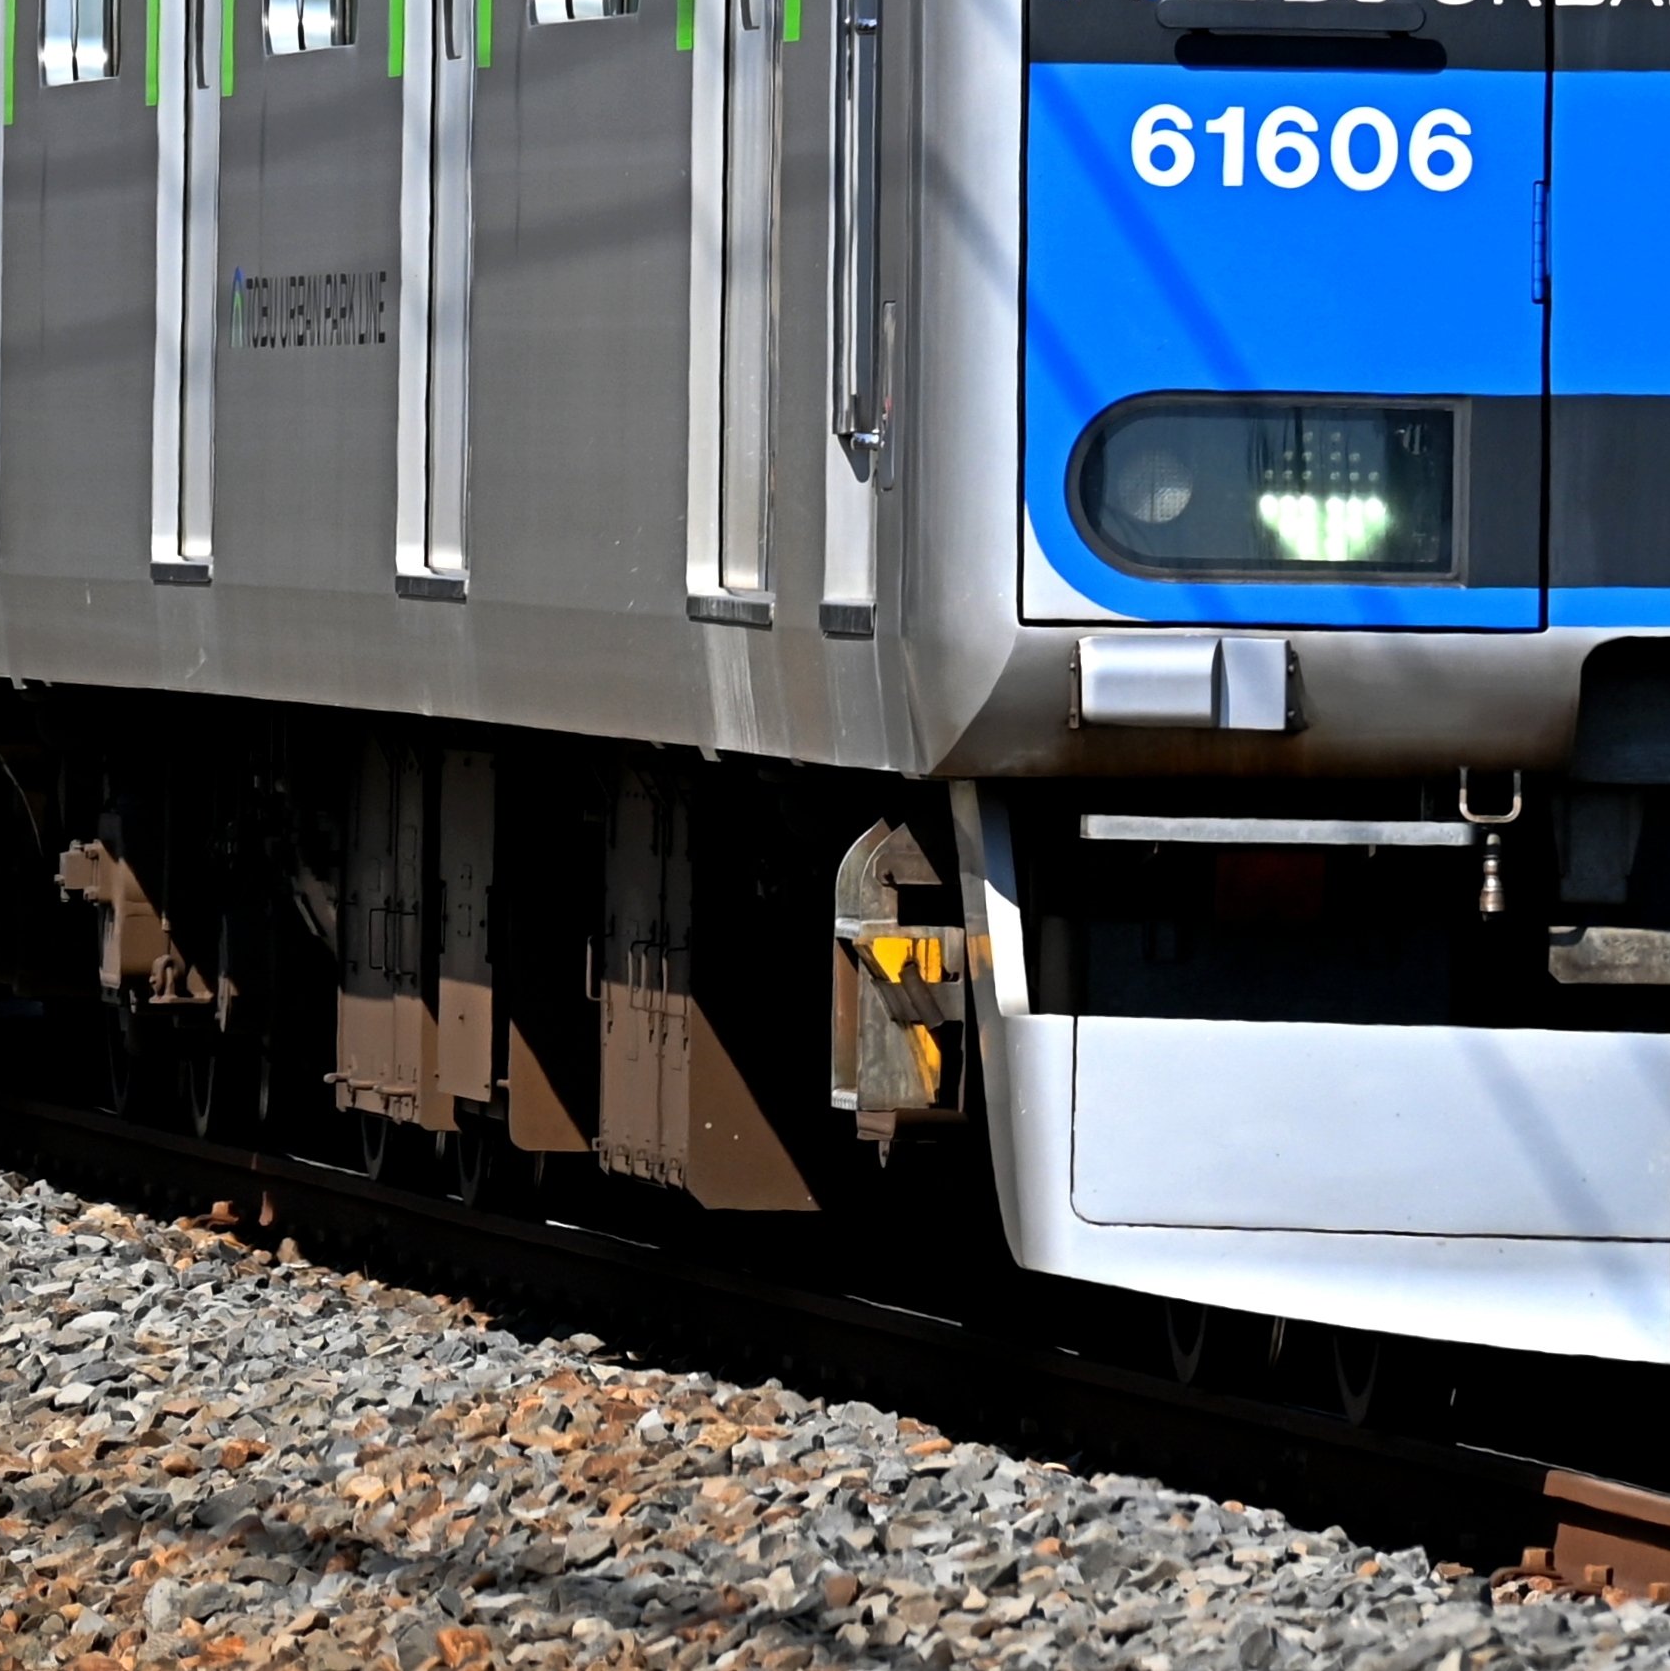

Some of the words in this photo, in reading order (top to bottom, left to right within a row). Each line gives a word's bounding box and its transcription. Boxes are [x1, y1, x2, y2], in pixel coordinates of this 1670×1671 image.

[1130, 102, 1474, 193] 61606
[246, 277, 276, 348] TOBU
[279, 275, 322, 347] URBAN
[323, 273, 356, 346] PARK
[357, 271, 387, 344] LINE
